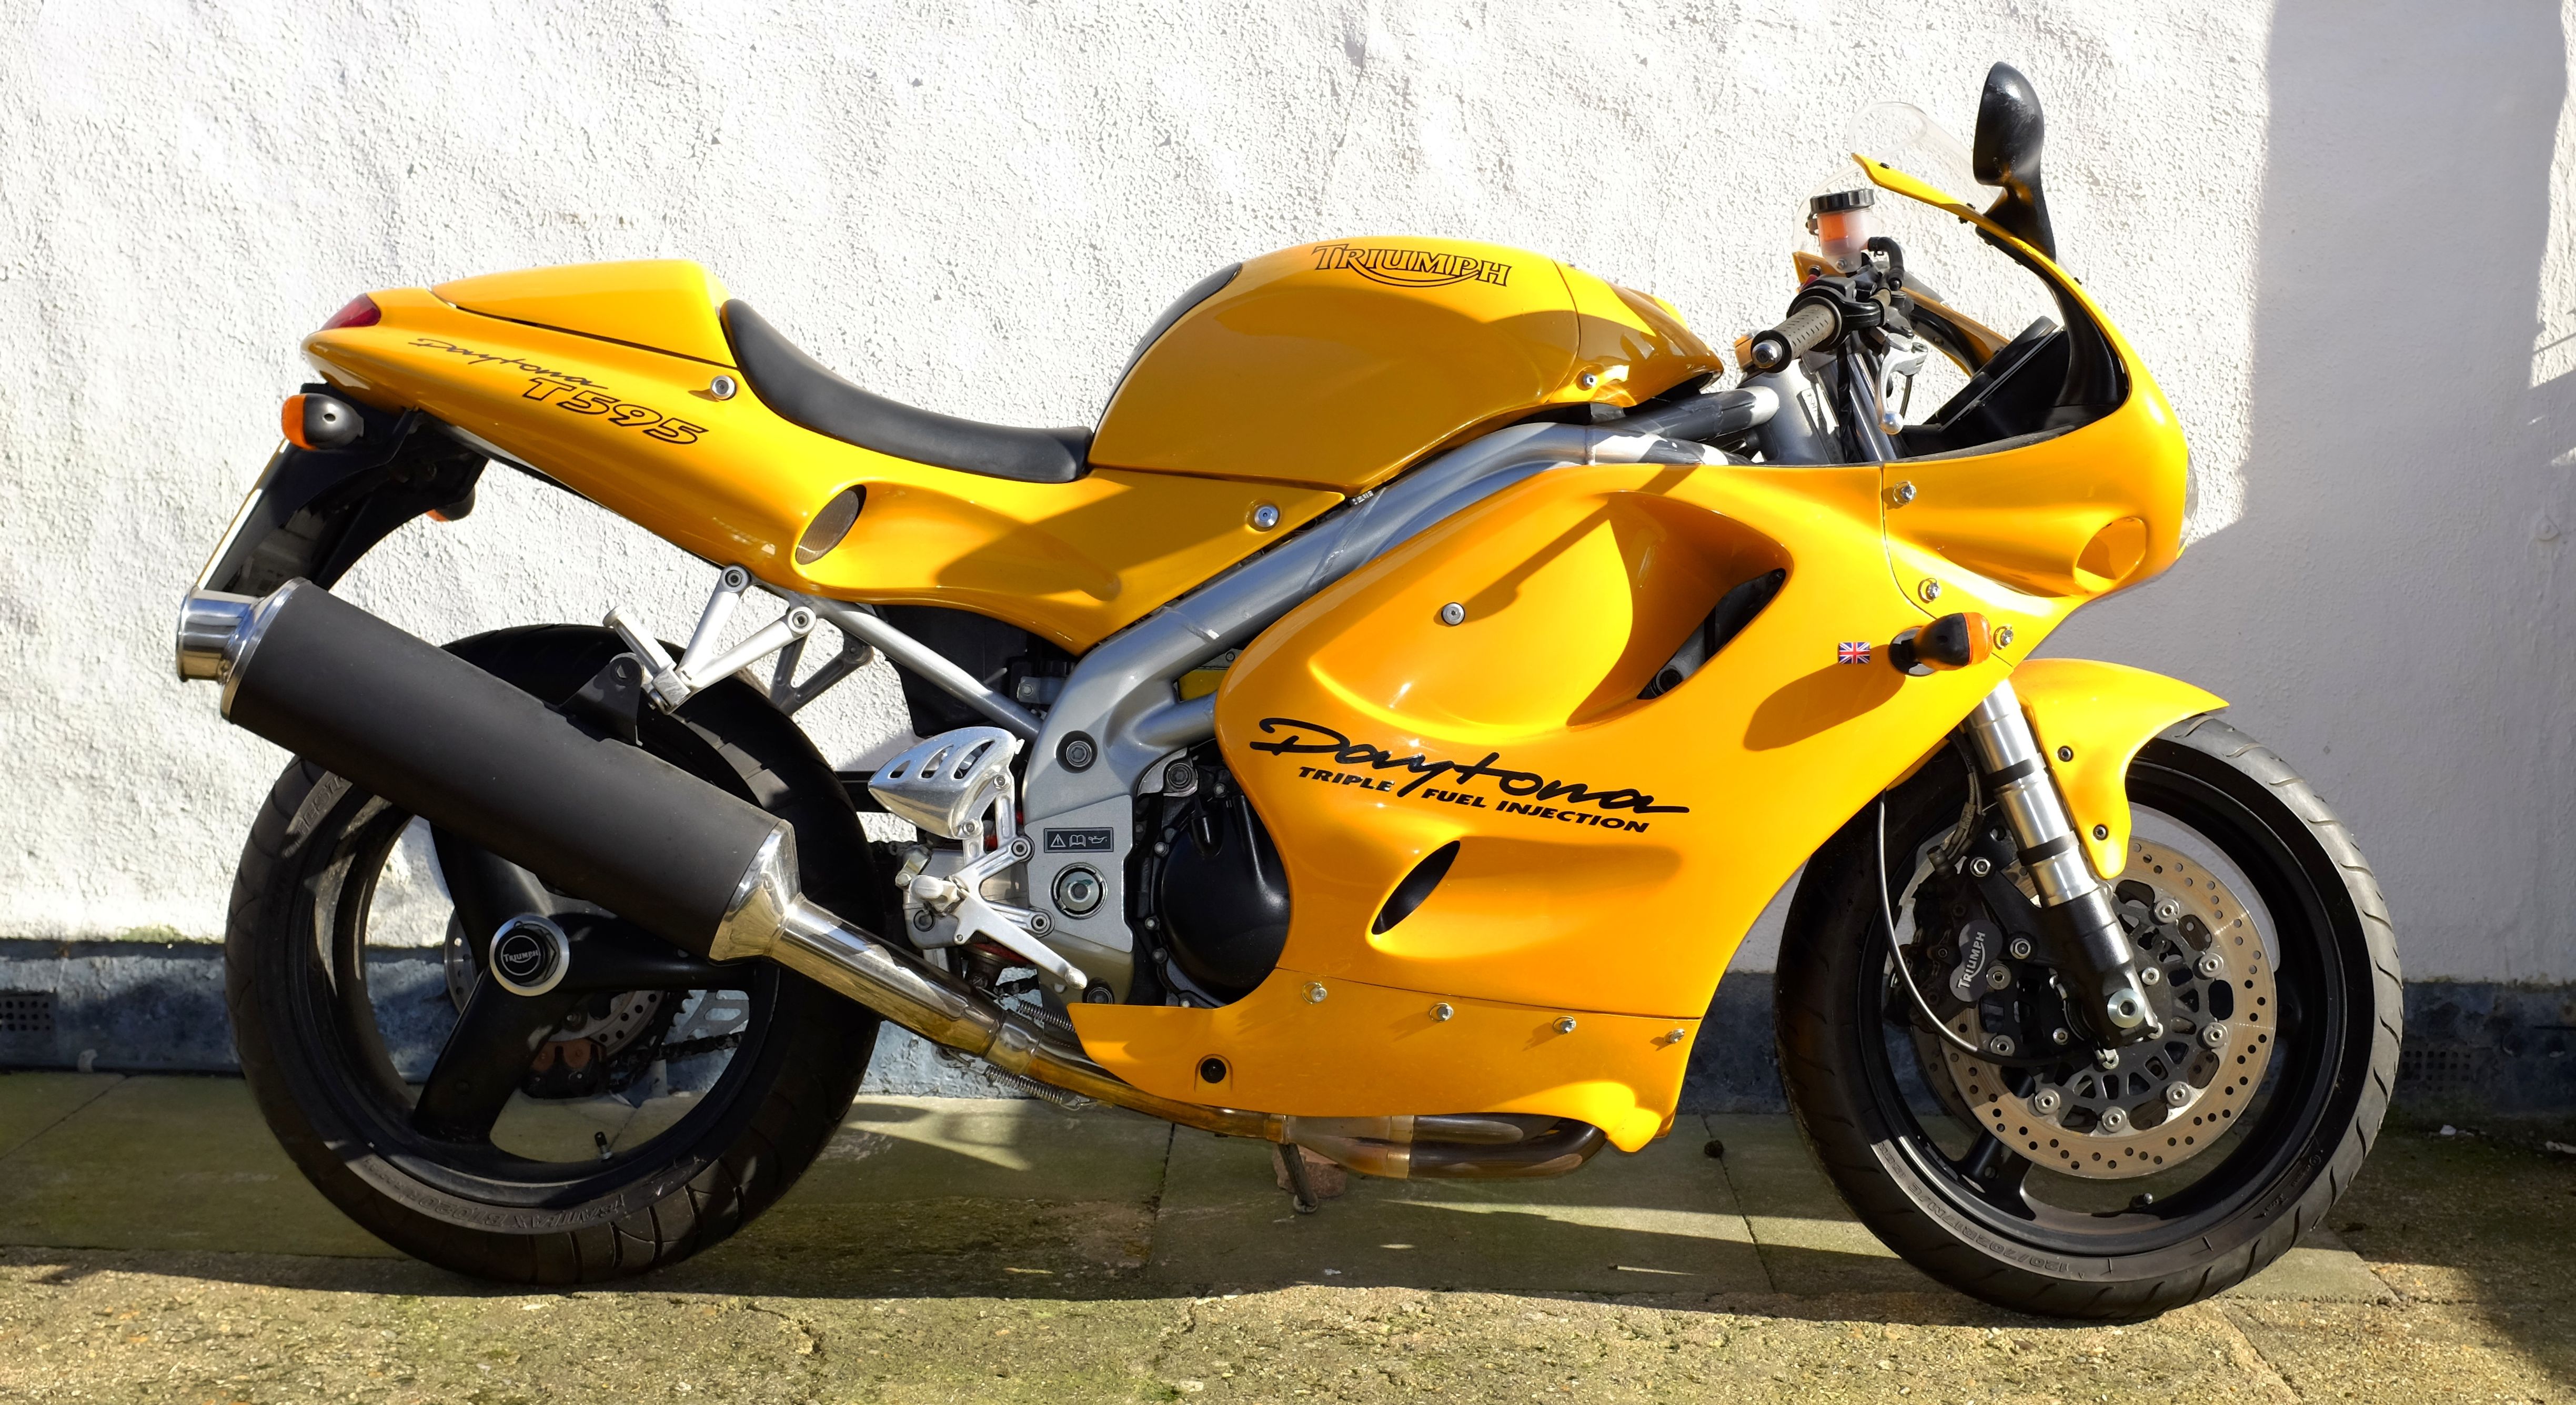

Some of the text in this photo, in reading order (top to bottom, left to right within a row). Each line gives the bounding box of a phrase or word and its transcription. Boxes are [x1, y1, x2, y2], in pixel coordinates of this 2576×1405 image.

[1311, 243, 1512, 287] TRIUMPH
[408, 338, 609, 390] Daytona
[522, 377, 709, 444] T595
[1249, 717, 1690, 813] Daytona
[1298, 766, 1650, 833] TRIPLE FUEL INJECTION
[503, 949, 539, 963] TRIUMPH
[1957, 931, 1986, 988] TRIUMPH
